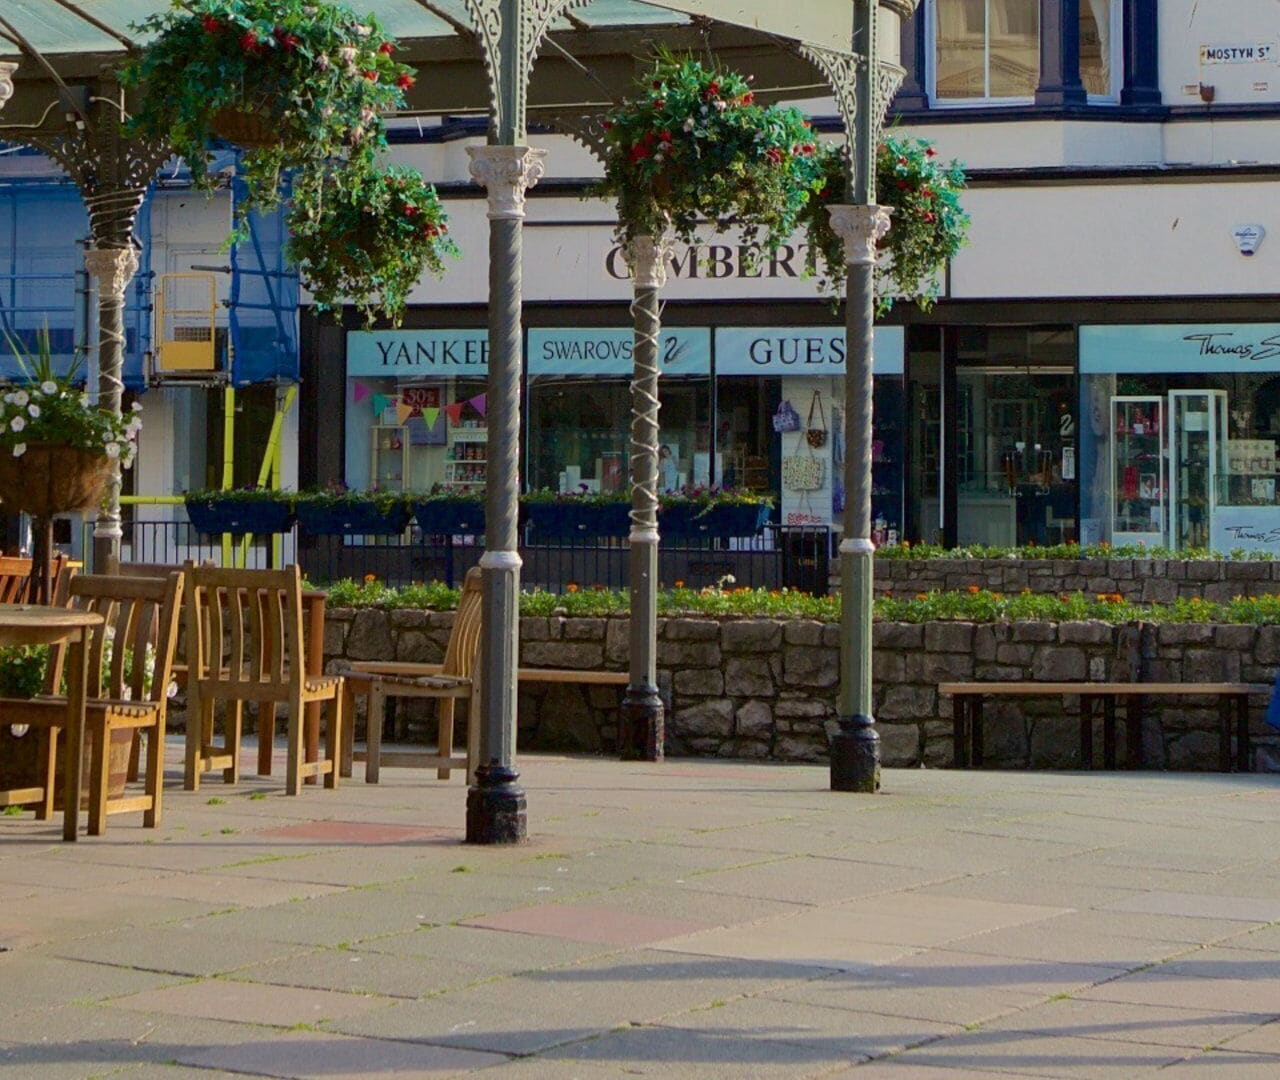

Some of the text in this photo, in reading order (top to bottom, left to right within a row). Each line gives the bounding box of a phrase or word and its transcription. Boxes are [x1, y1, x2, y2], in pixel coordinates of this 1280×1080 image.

[605, 244, 821, 280] GMBERT
[542, 340, 633, 361] SWAROVS
[749, 338, 845, 366] GUES
[1183, 333, 1254, 359] Thomas
